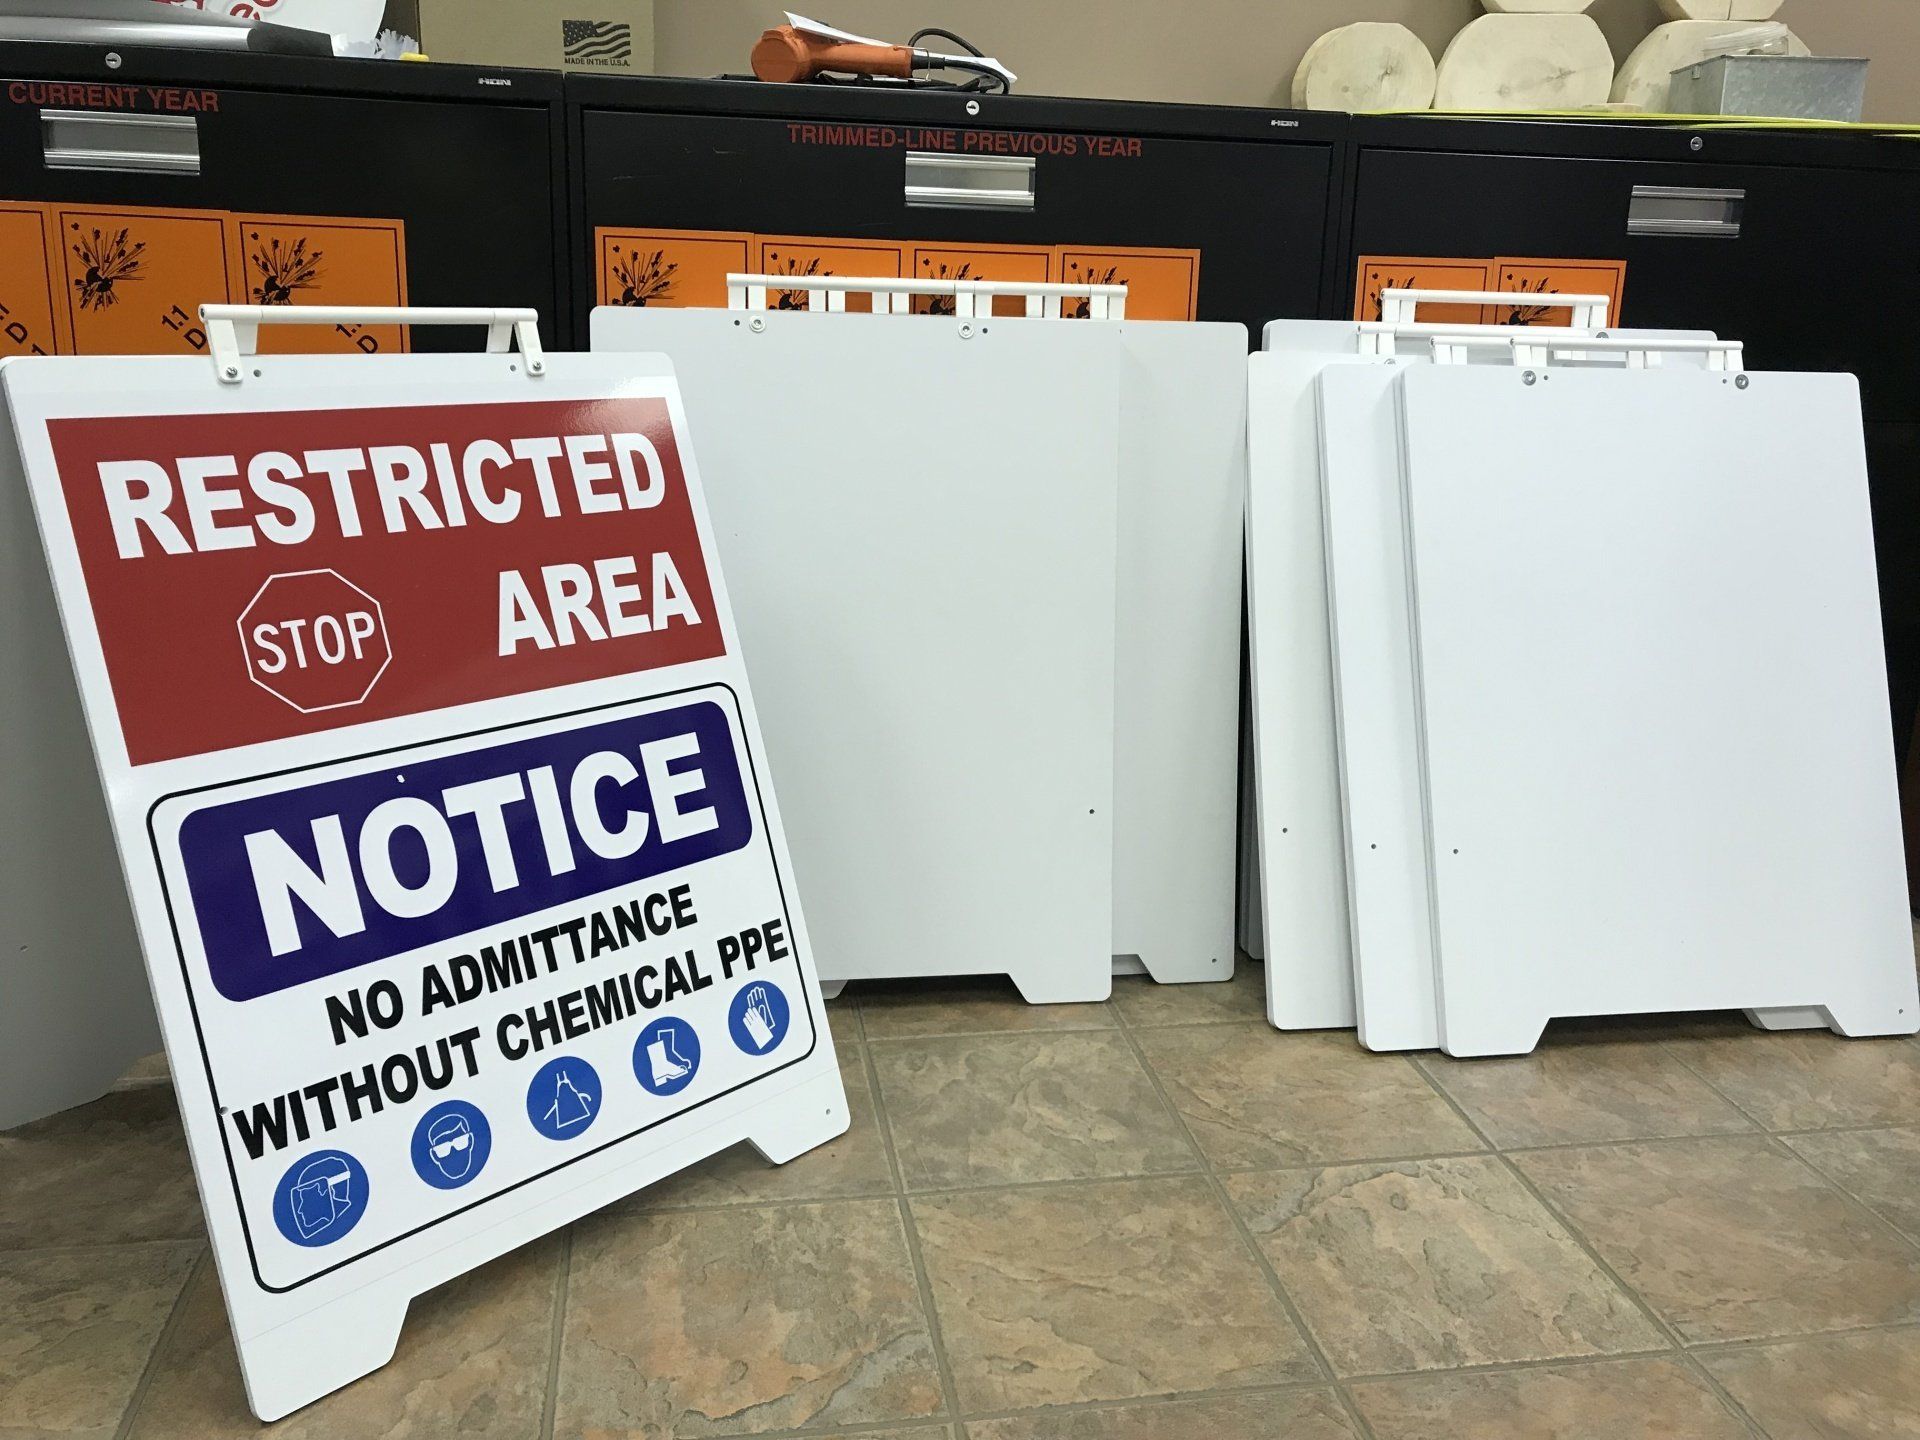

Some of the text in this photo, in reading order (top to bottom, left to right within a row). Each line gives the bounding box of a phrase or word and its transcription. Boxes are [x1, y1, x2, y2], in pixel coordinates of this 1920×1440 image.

[564, 57, 585, 65] MADE
[8, 82, 219, 112] CURRENT YEAR
[787, 124, 1142, 158] TRIMMED-LINE PREVIOUS YEAR
[5, 322, 28, 344] D
[161, 304, 190, 331] 1.1
[356, 335, 378, 354] D
[96, 432, 667, 560] RESTRICTED
[497, 551, 702, 657] AREA
[252, 610, 376, 675] STOP
[243, 731, 720, 958] NOTICE
[325, 884, 698, 1046] NO ADMITTANCE
[232, 918, 789, 1161] WITHOUT CHEMICAL PPE
